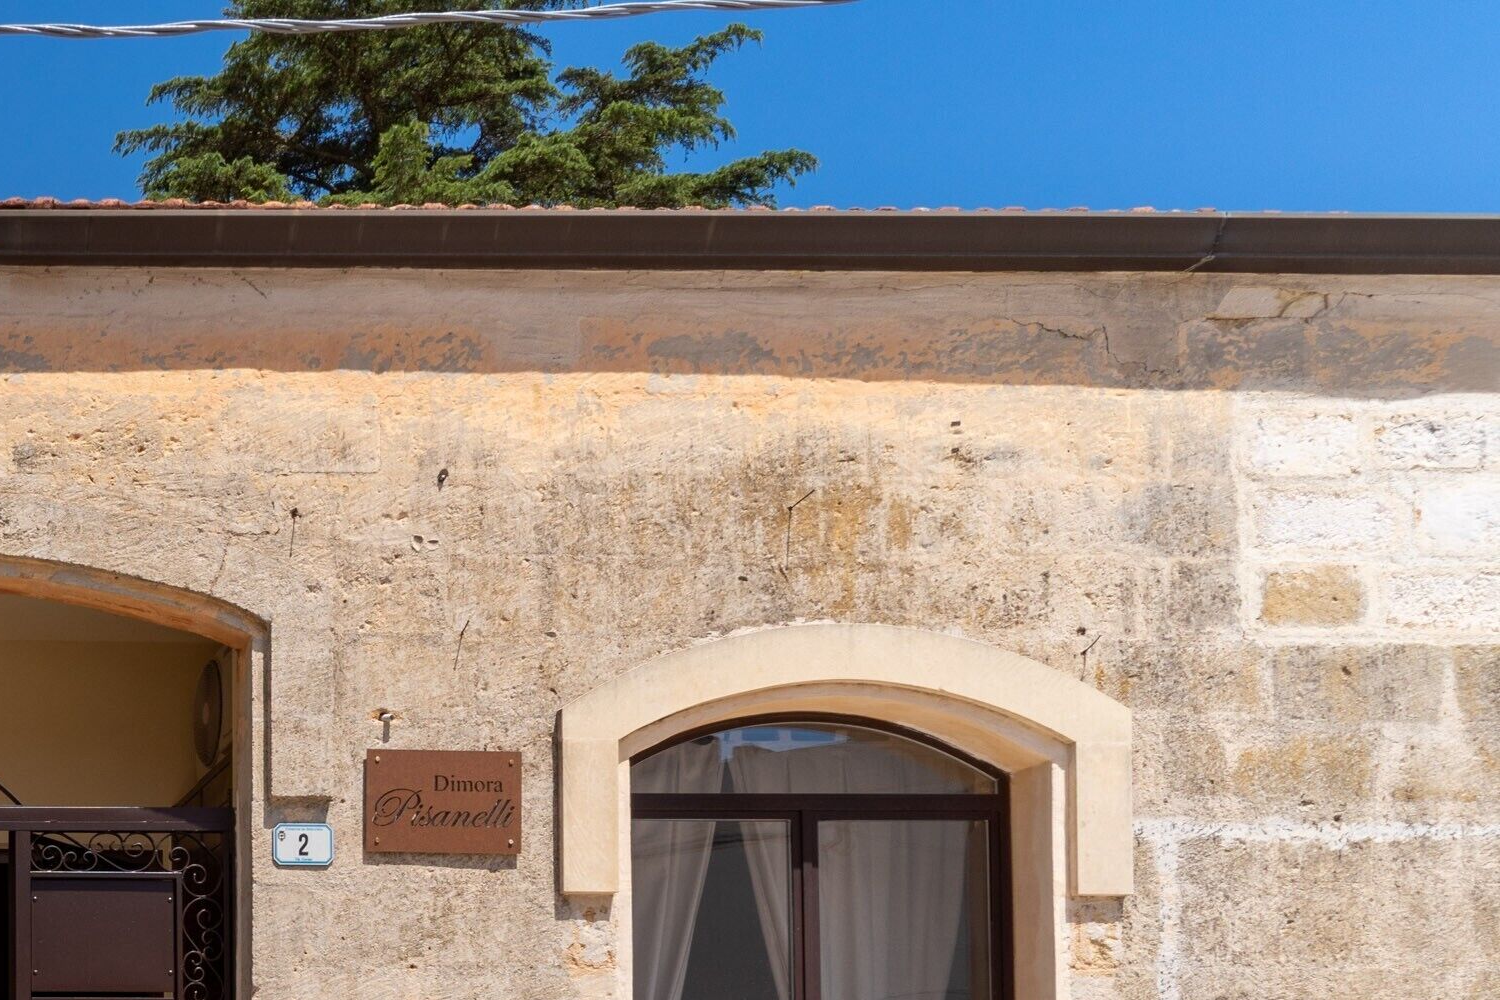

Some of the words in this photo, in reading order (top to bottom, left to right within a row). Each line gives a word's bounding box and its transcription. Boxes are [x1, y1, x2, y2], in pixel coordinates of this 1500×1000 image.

[433, 774, 504, 793] Dimora
[371, 787, 516, 828] Pisanelli
[298, 832, 309, 856] 2
